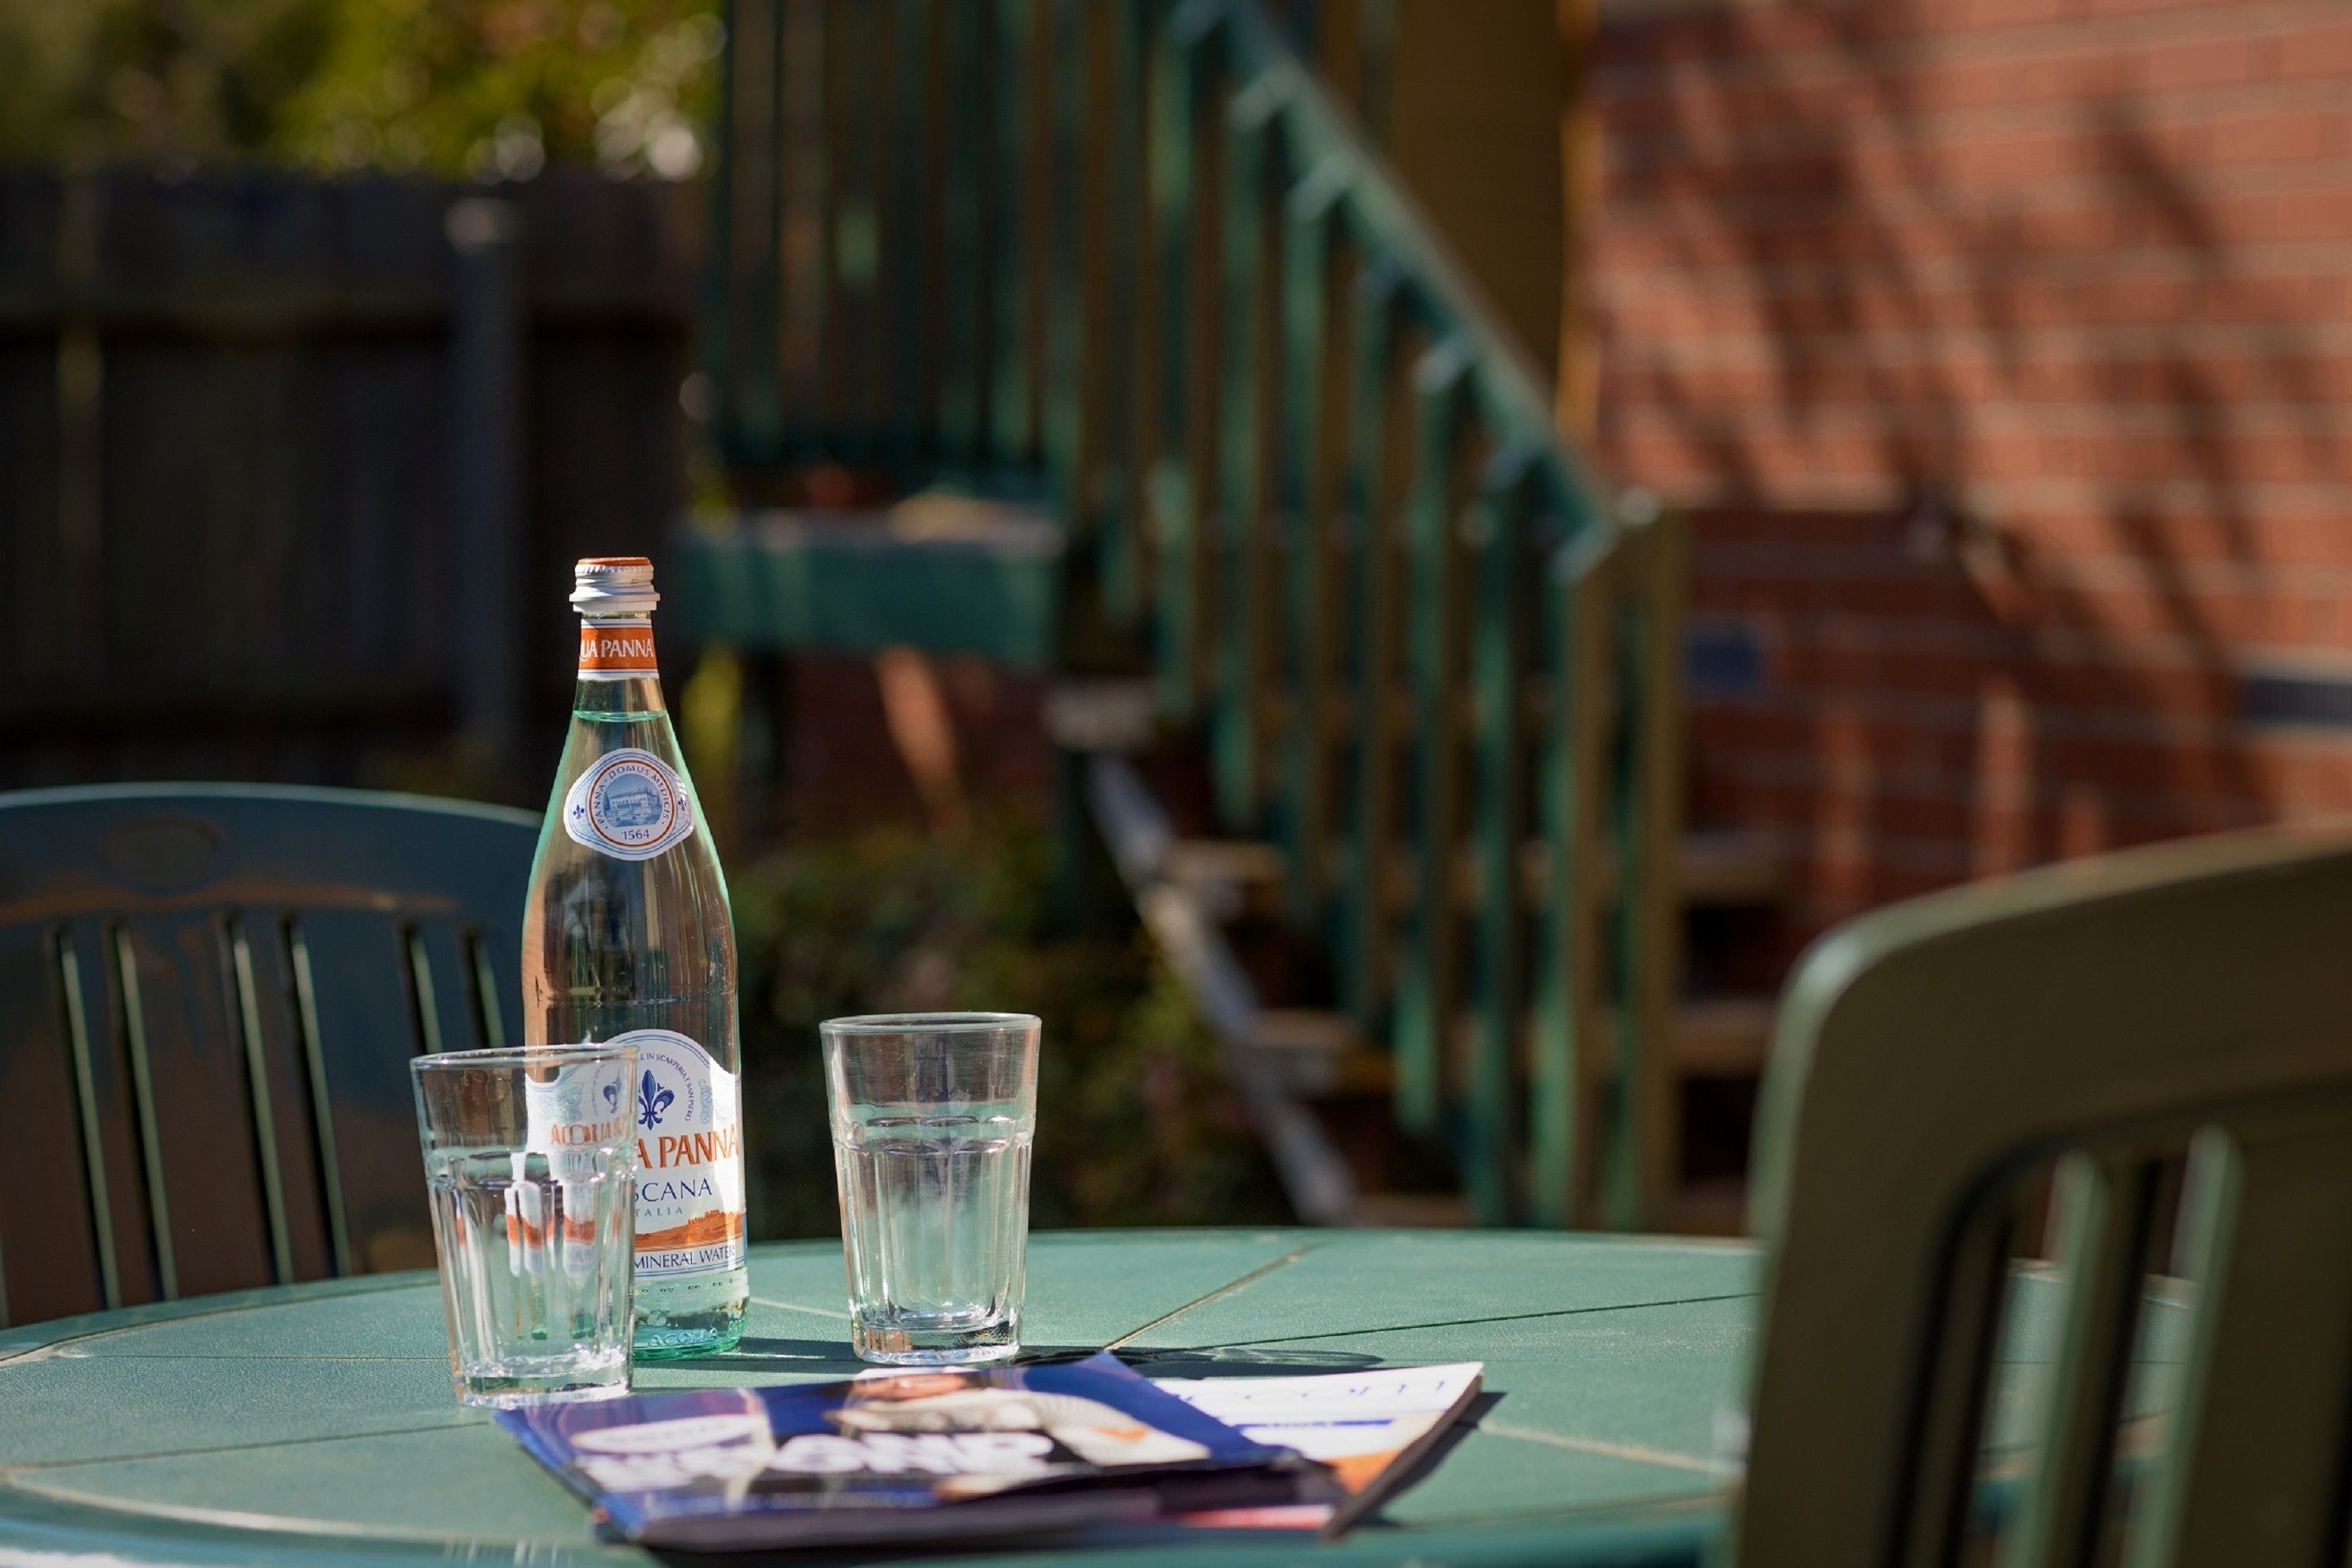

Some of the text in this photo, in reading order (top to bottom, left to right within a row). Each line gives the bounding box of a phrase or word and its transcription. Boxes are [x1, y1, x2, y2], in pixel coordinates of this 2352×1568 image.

[581, 639, 653, 662] UA PANNA
[595, 766, 670, 825] PANNA DOMUS MEDICIS
[622, 829, 649, 840] 1564
[658, 1124, 739, 1168] PANNA
[635, 1245, 734, 1268] MINERAL WATER
